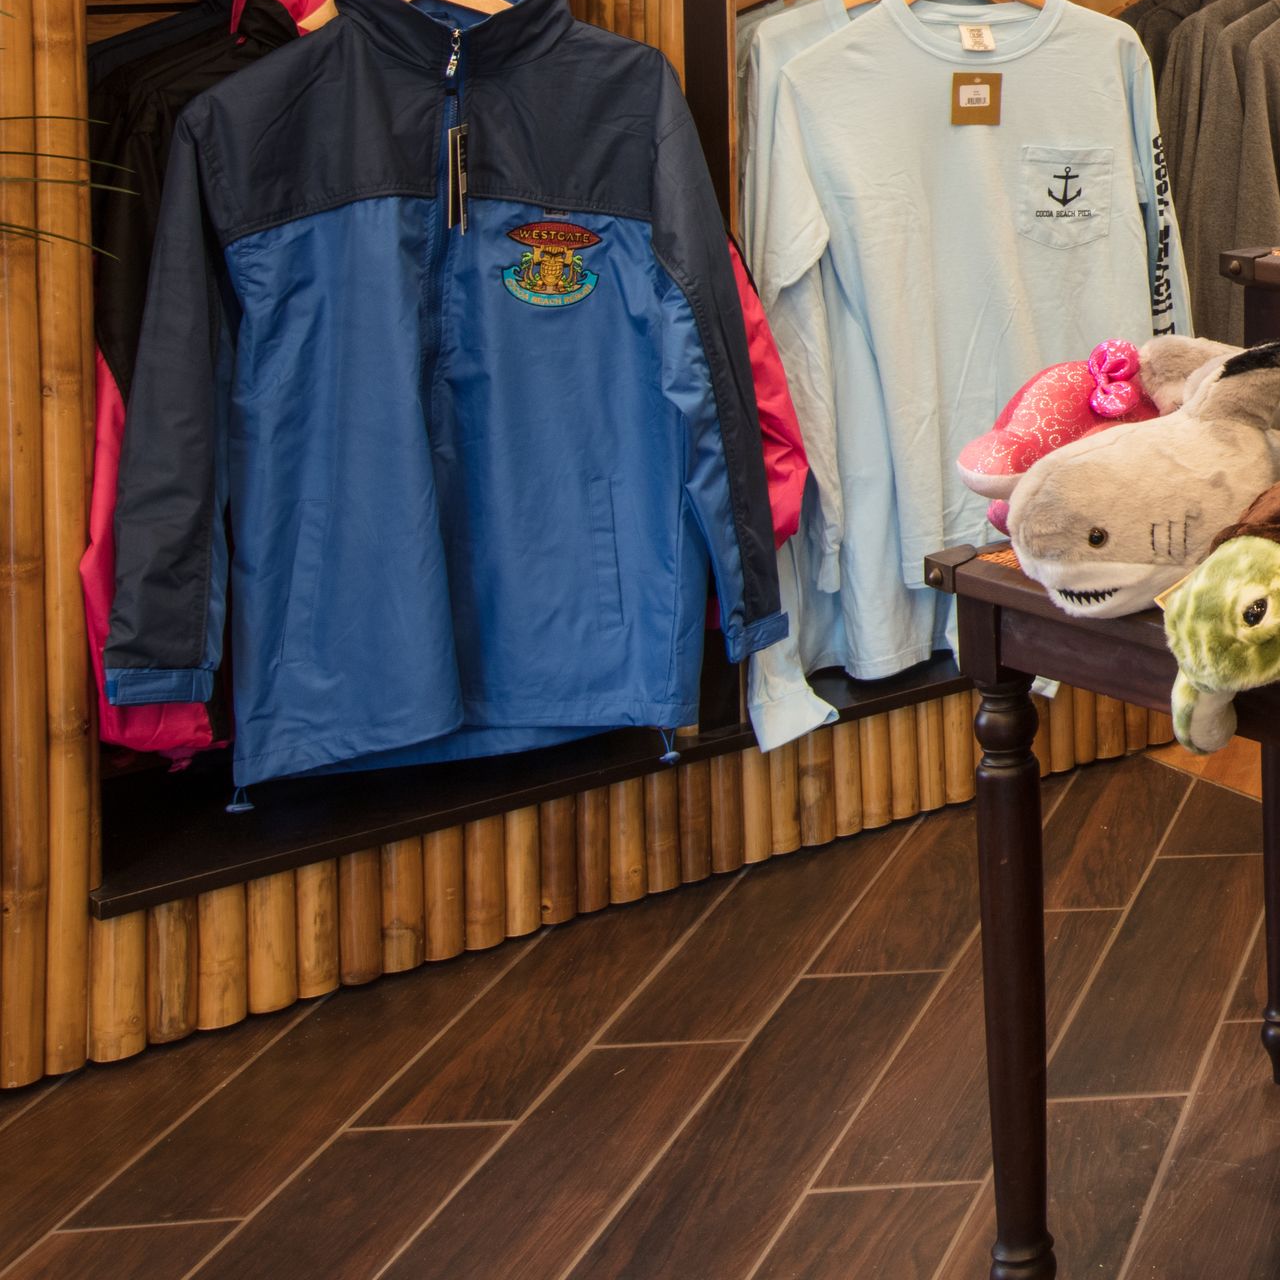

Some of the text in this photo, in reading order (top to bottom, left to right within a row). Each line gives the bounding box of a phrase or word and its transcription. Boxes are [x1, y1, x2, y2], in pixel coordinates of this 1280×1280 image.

[1035, 209, 1092, 218] COCOA BEACH PIER
[519, 229, 591, 243] WESTGATE
